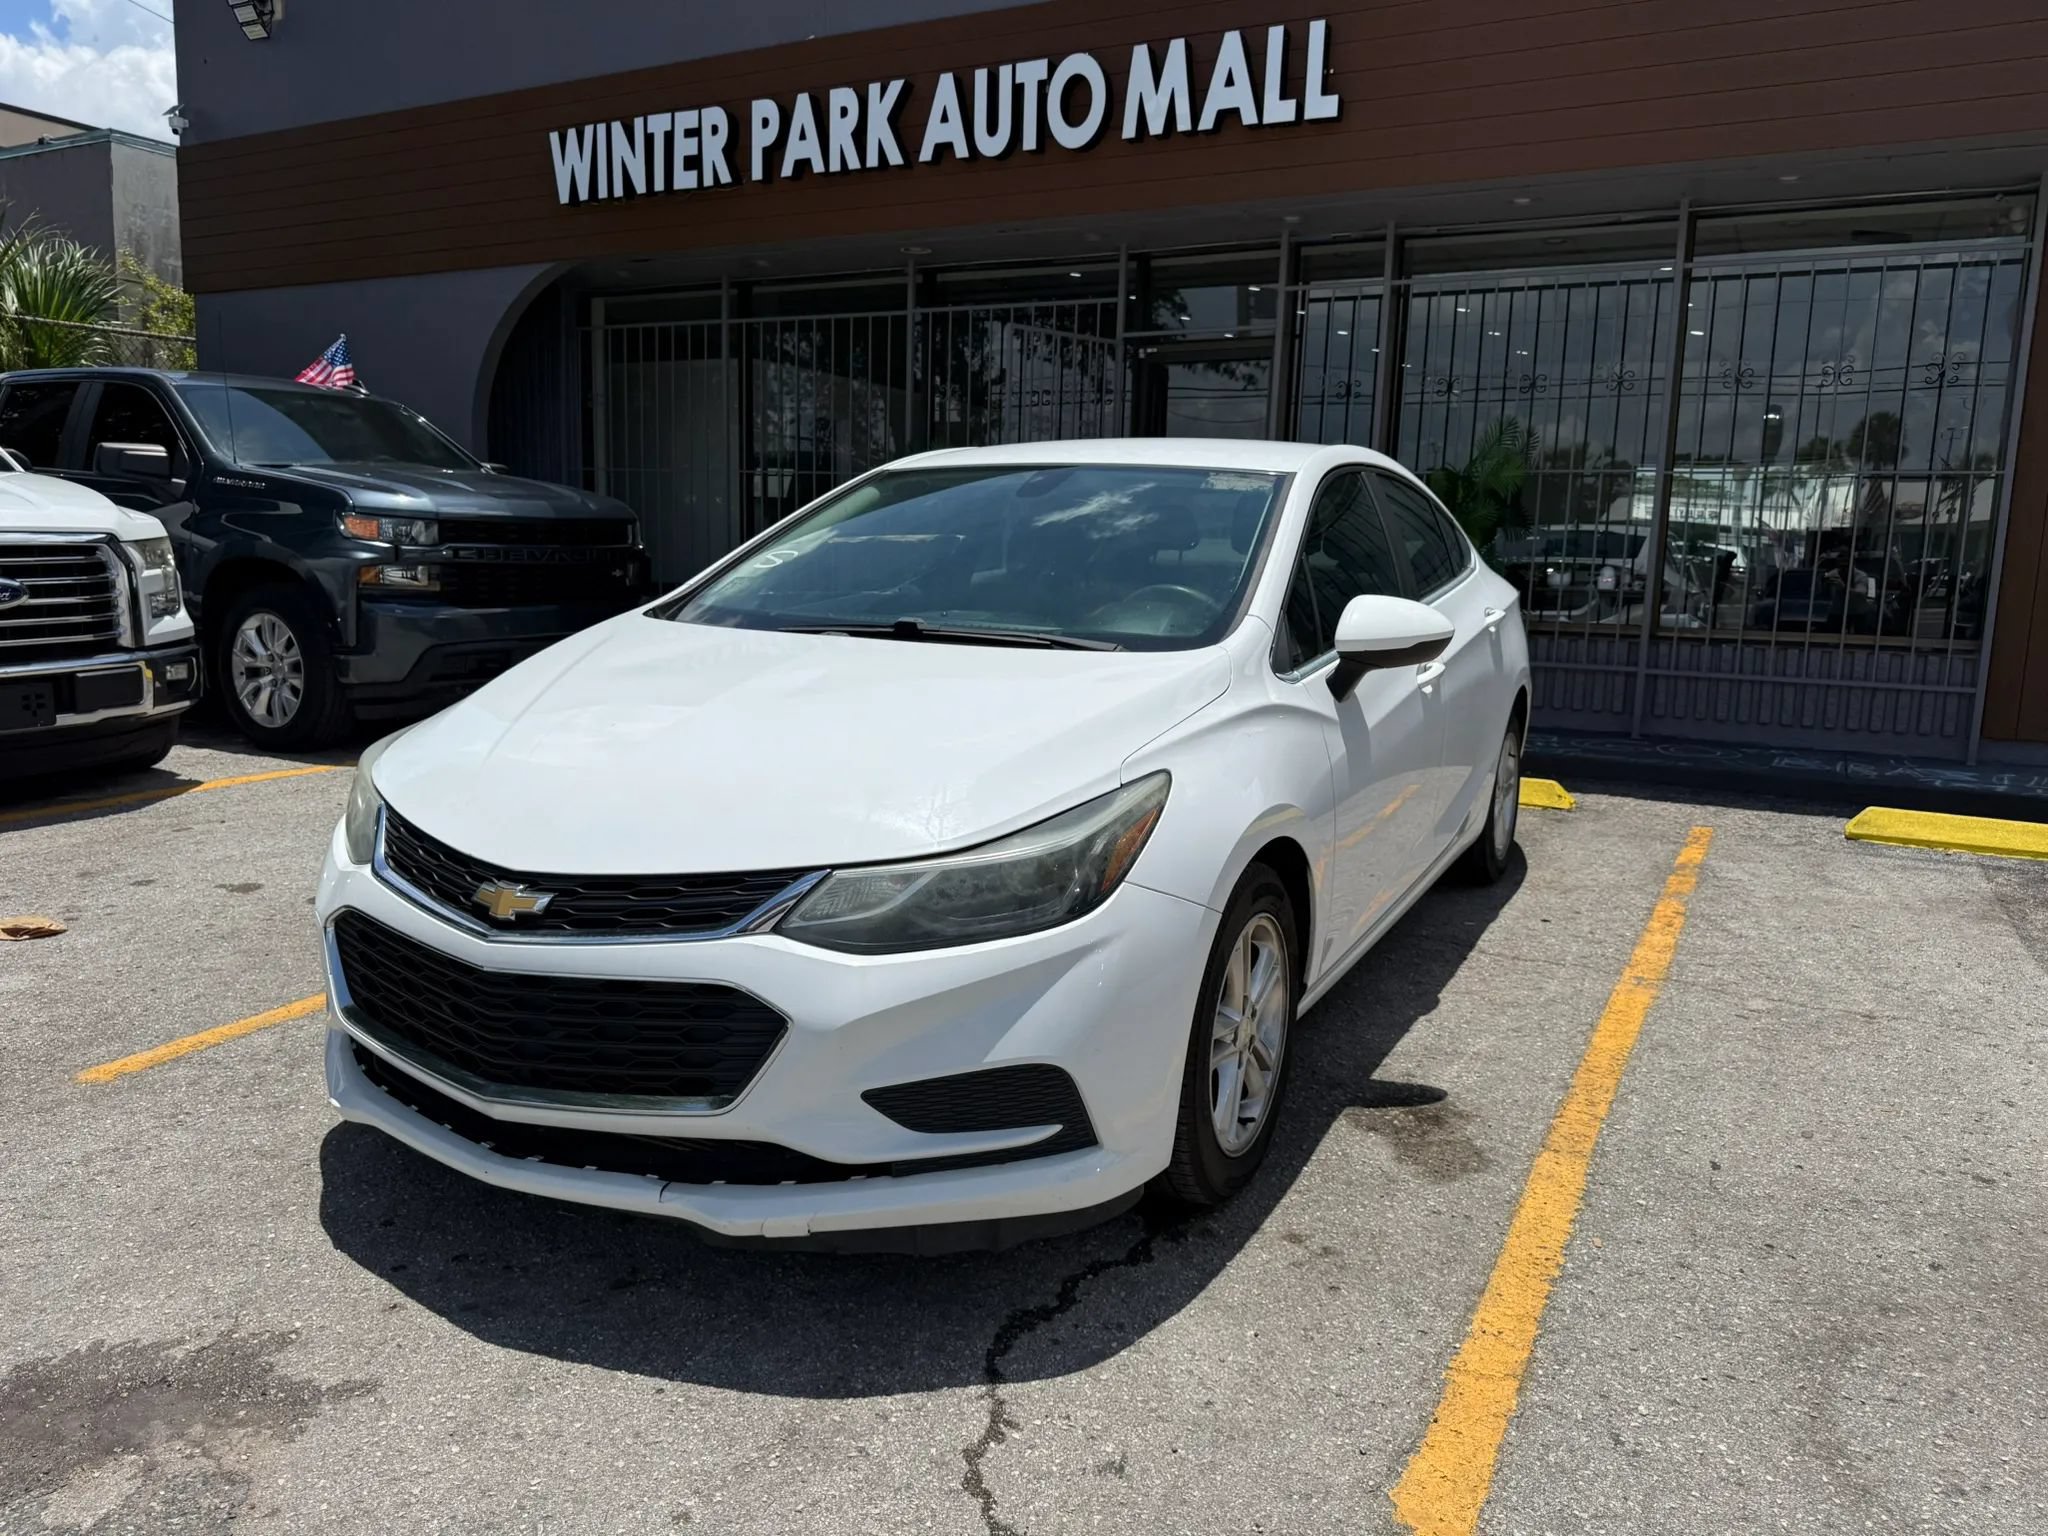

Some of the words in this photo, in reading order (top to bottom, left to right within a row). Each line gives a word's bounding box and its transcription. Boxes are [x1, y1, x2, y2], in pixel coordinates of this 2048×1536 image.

[549, 106, 733, 205] WINTER
[751, 79, 906, 181] PARK
[918, 58, 1107, 162] AUTO
[1121, 19, 1340, 140] MALL
